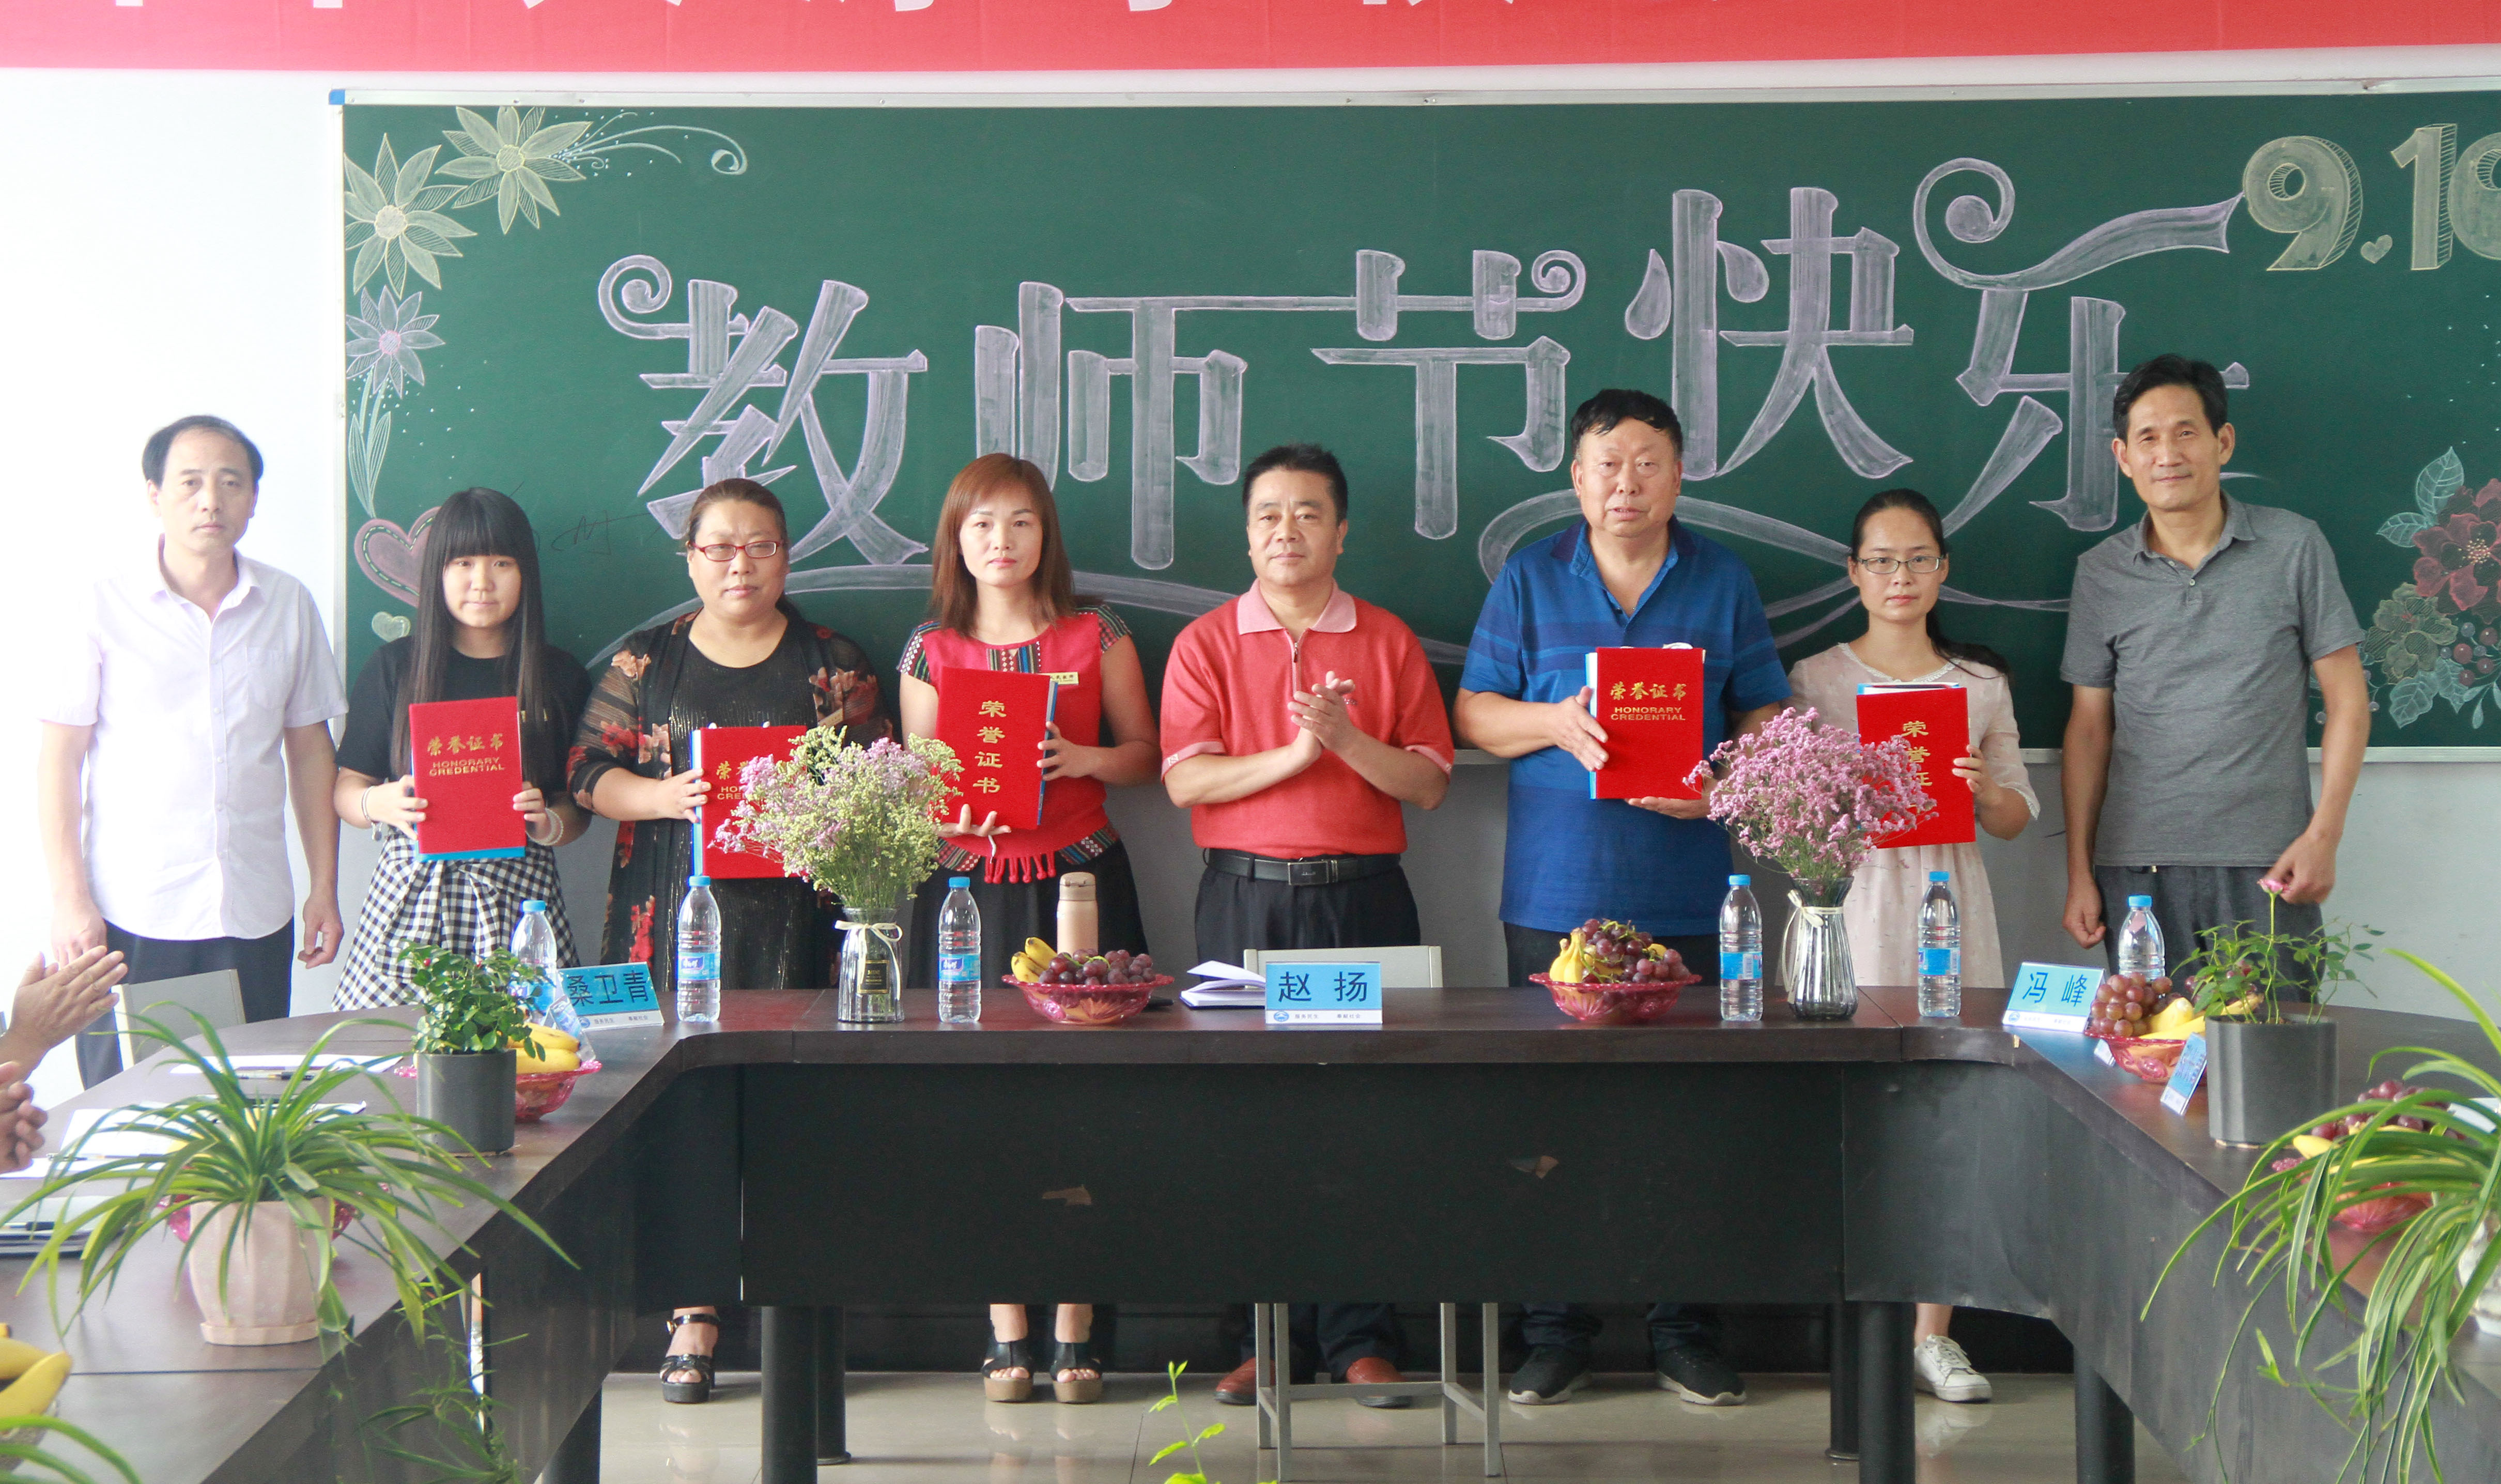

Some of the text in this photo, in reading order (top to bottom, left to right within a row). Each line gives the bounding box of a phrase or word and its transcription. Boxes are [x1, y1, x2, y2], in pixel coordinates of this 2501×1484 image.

[598, 157, 2249, 569] 教师节快乐
[1610, 682, 1686, 700] 荣誉证书
[427, 733, 503, 756] 荣誉证书
[972, 700, 1007, 794] 荣誉证书
[429, 764, 505, 776] CREDENTIAL
[433, 757, 500, 768] HONORARY
[567, 970, 649, 1007] 桑卫青
[1278, 971, 1367, 1002] 赵扬
[2022, 971, 2088, 1007] 冯峰
